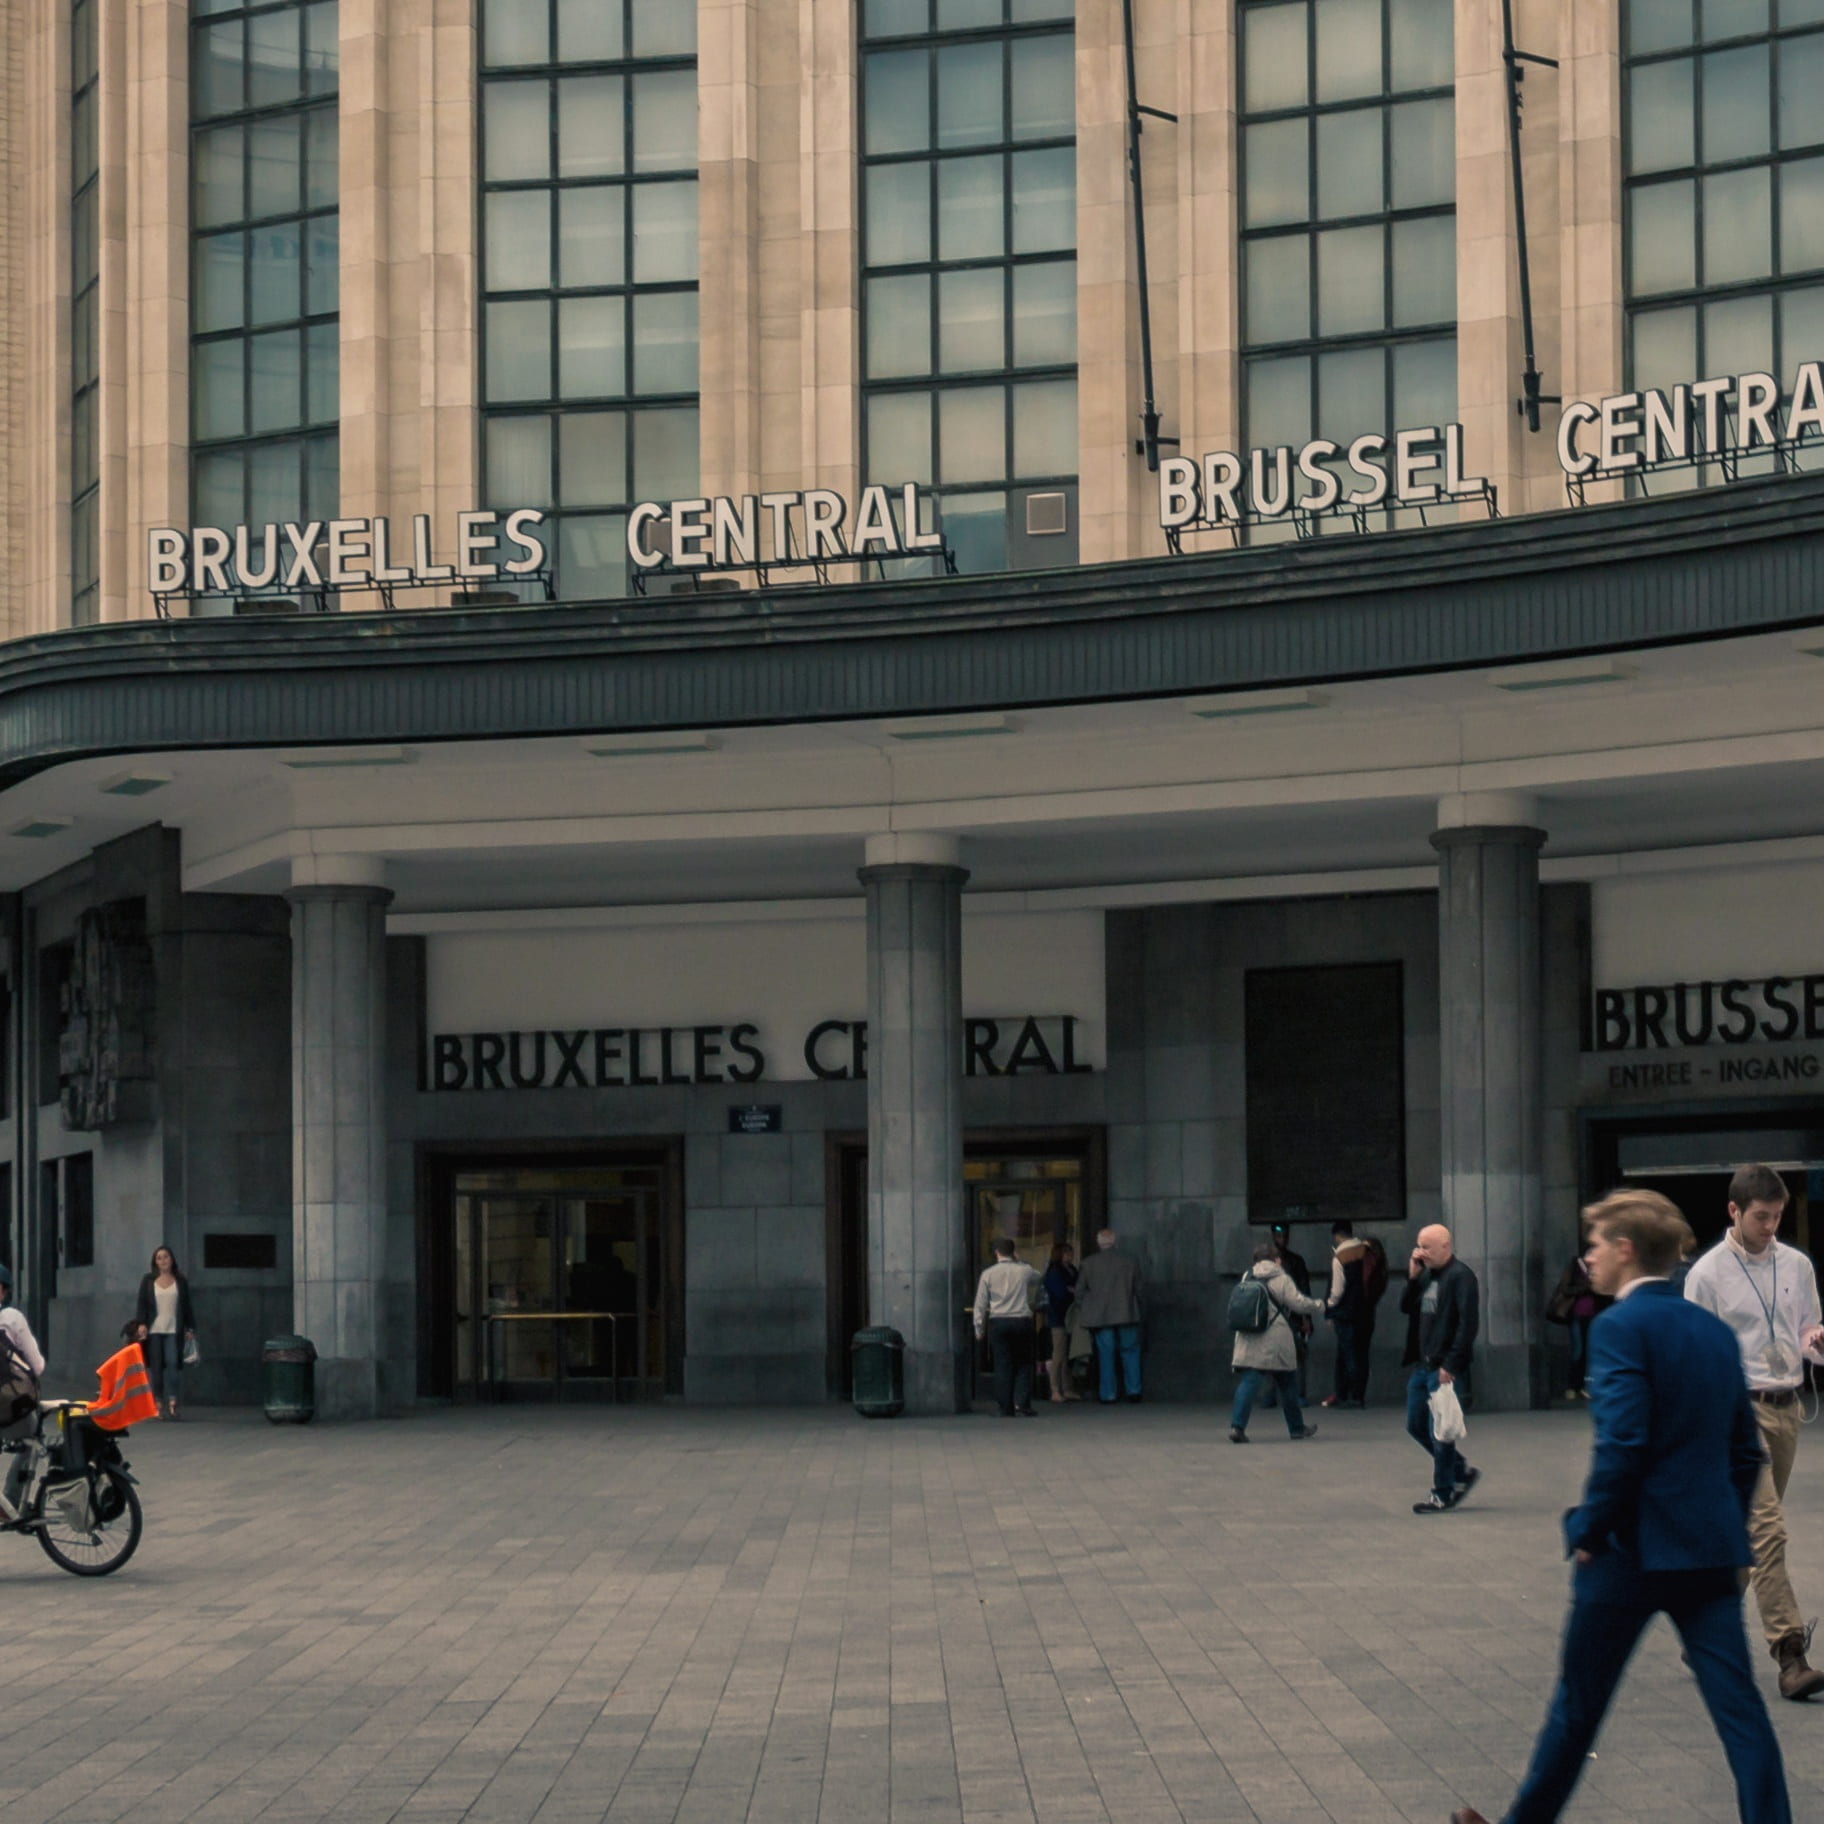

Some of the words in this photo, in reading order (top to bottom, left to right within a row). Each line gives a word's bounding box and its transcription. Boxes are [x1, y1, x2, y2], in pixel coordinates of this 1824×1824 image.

[1157, 423, 1487, 530] BRUSSEL
[148, 507, 547, 593] BRUXELLES
[628, 482, 942, 568] CENTRAL
[434, 1023, 765, 1090] BRUXELLES
[804, 1015, 1092, 1080] CERAL
[1609, 1061, 1692, 1089] ENTREE
[1719, 1054, 1821, 1084] INGANG
